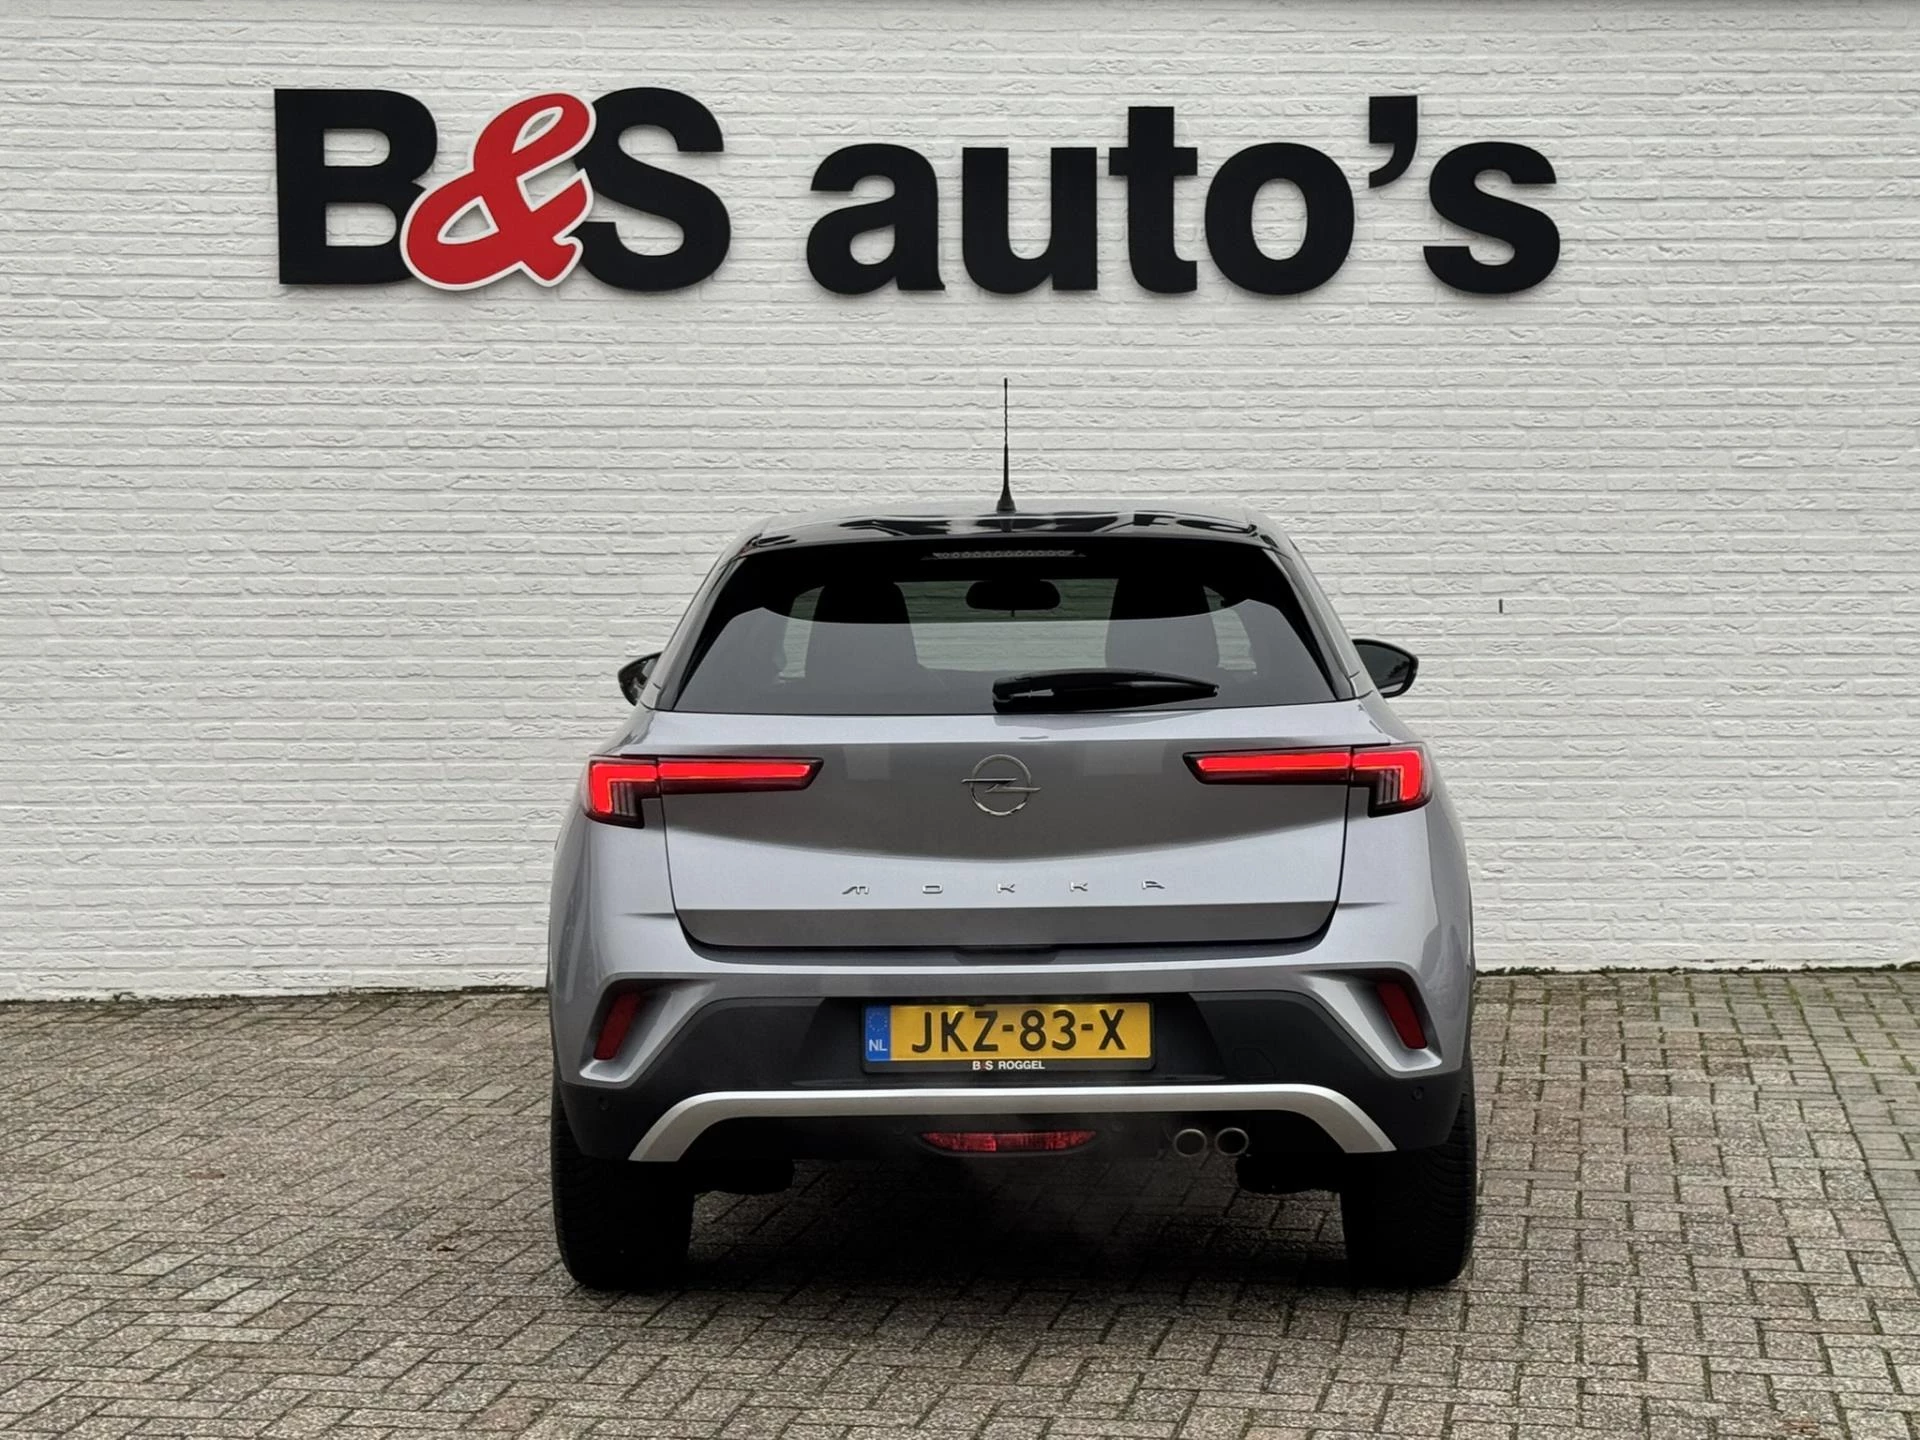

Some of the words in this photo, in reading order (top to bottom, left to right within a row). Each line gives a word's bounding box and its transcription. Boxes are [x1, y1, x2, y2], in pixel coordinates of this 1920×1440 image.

[274, 86, 731, 293] B&S
[806, 95, 1561, 295] auto's
[842, 880, 1165, 894] MOKKA
[911, 1008, 1126, 1053] JKZ-83-X
[868, 1039, 888, 1052] NL
[998, 1060, 1046, 1070] ROGGEL
